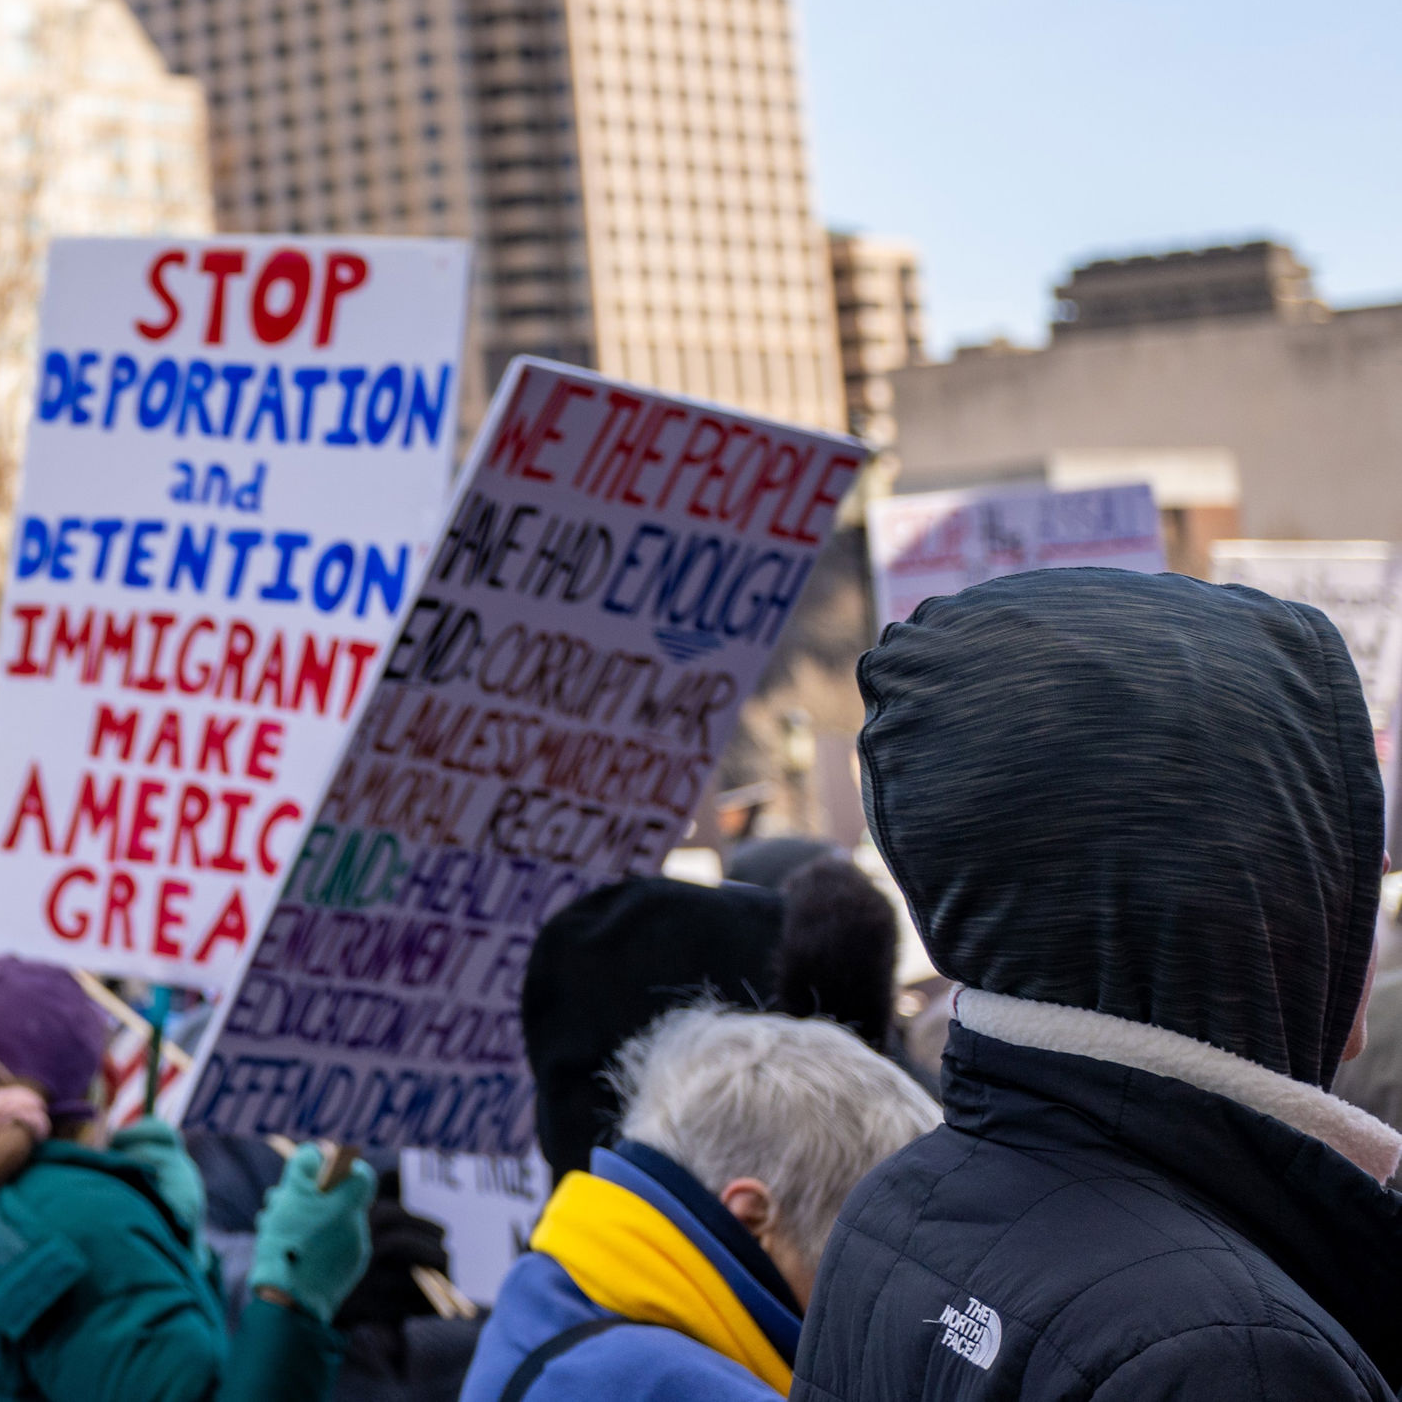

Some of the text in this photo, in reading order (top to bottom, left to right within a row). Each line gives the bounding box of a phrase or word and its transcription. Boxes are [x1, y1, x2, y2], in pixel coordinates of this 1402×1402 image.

[133, 246, 371, 348] STOP
[38, 348, 452, 450] DEPORTATION
[169, 460, 267, 512] and
[488, 370, 594, 482] WE
[574, 392, 688, 505] THE
[657, 416, 859, 546] PEOPLE
[15, 517, 410, 620] DETENTION
[434, 491, 540, 591] HAVE
[517, 519, 614, 601] HAD
[603, 521, 816, 647] ENOUGH
[5, 604, 379, 723] IMMIGRANT
[477, 623, 653, 724] CORRUPT
[90, 702, 284, 782] MAKE
[1, 764, 304, 878] AMERIC
[483, 787, 667, 875] REGIME
[44, 866, 250, 968] GREA
[185, 1053, 357, 1135] DEFEND
[939, 1304, 985, 1343] NORTH
[941, 1327, 977, 1358] FACE
[965, 1297, 991, 1324] THE
